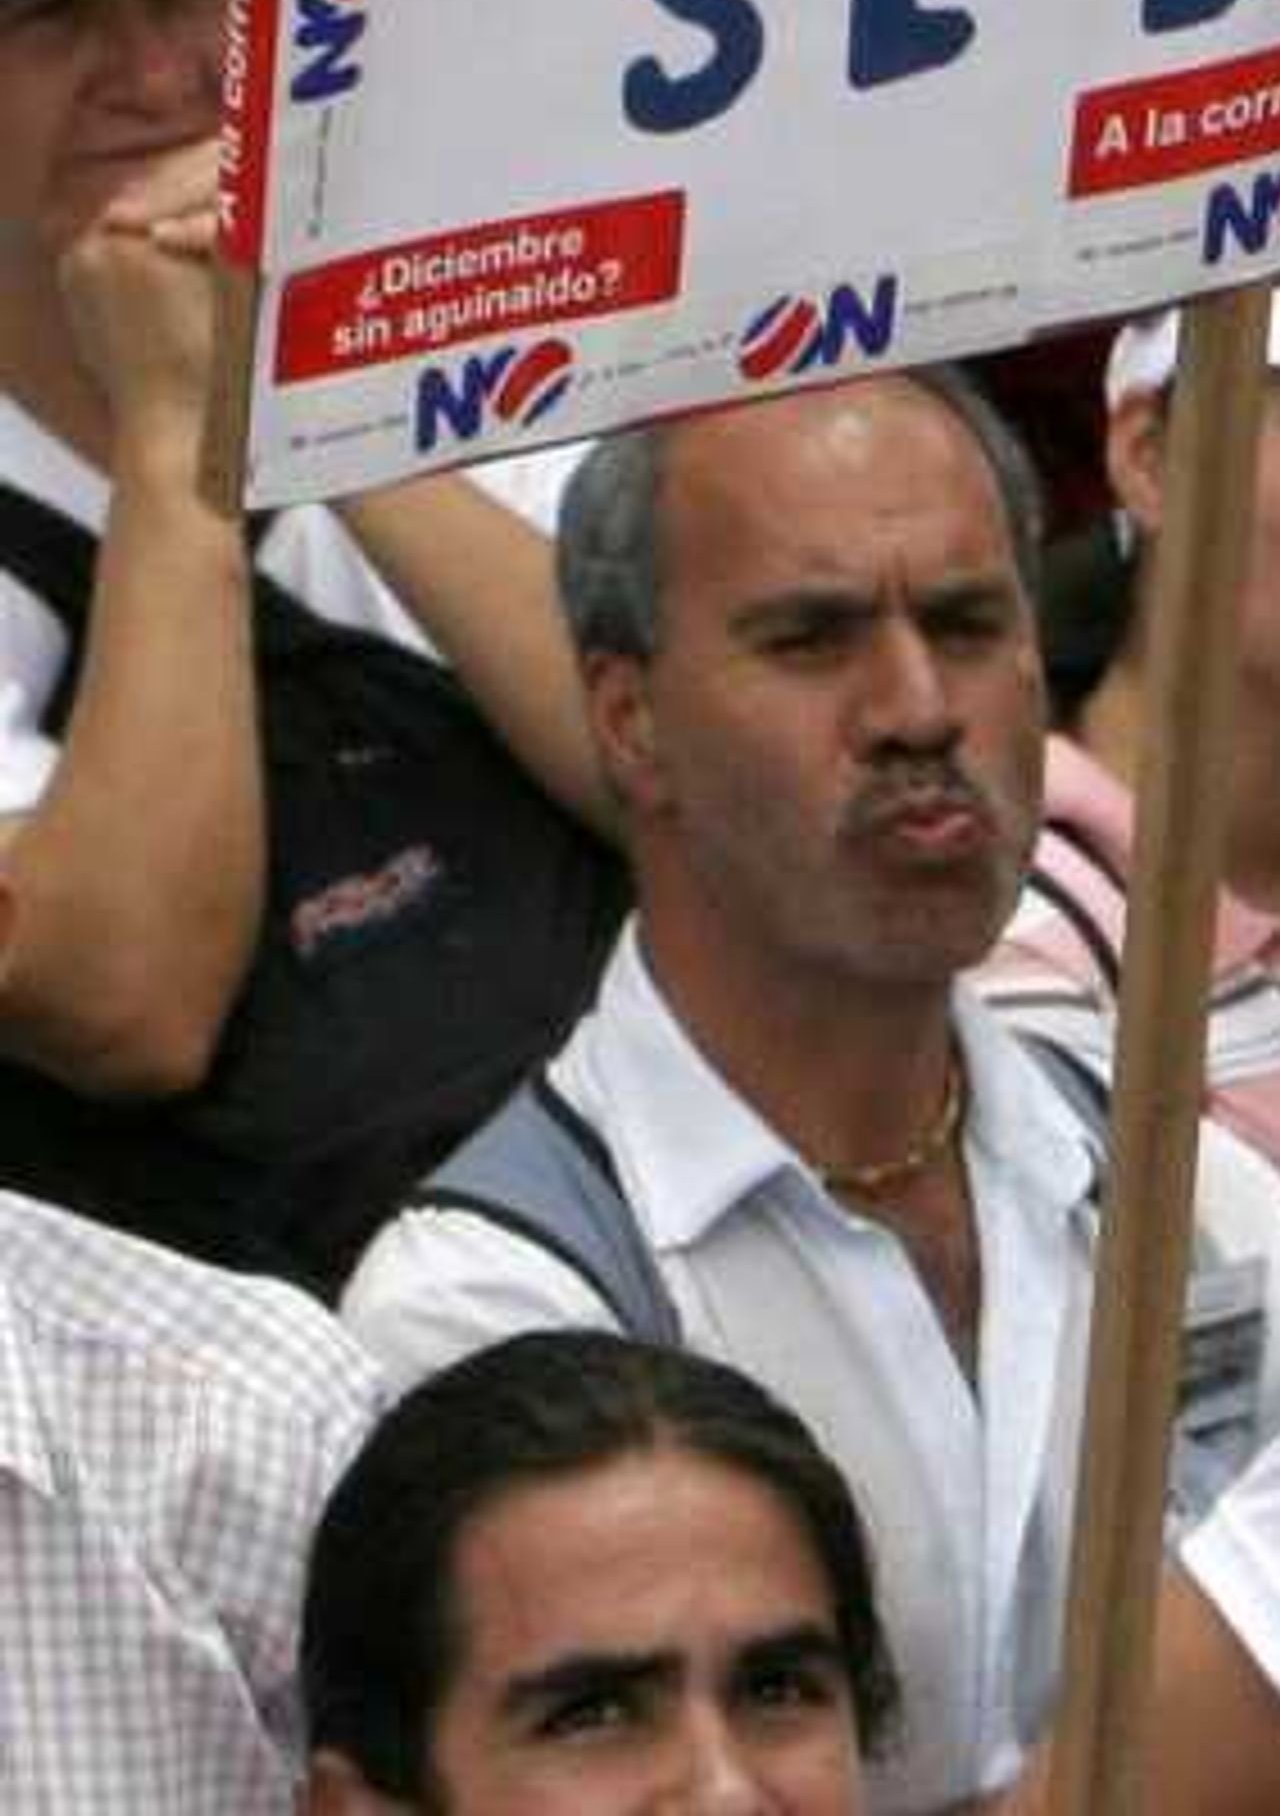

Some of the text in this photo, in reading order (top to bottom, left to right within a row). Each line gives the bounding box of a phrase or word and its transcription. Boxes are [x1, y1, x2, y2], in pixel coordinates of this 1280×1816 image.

[1094, 112, 1129, 159] A
[1144, 106, 1187, 149] la
[358, 225, 584, 307] ¿Diciembre
[333, 259, 623, 357] sin aguinaldo?
